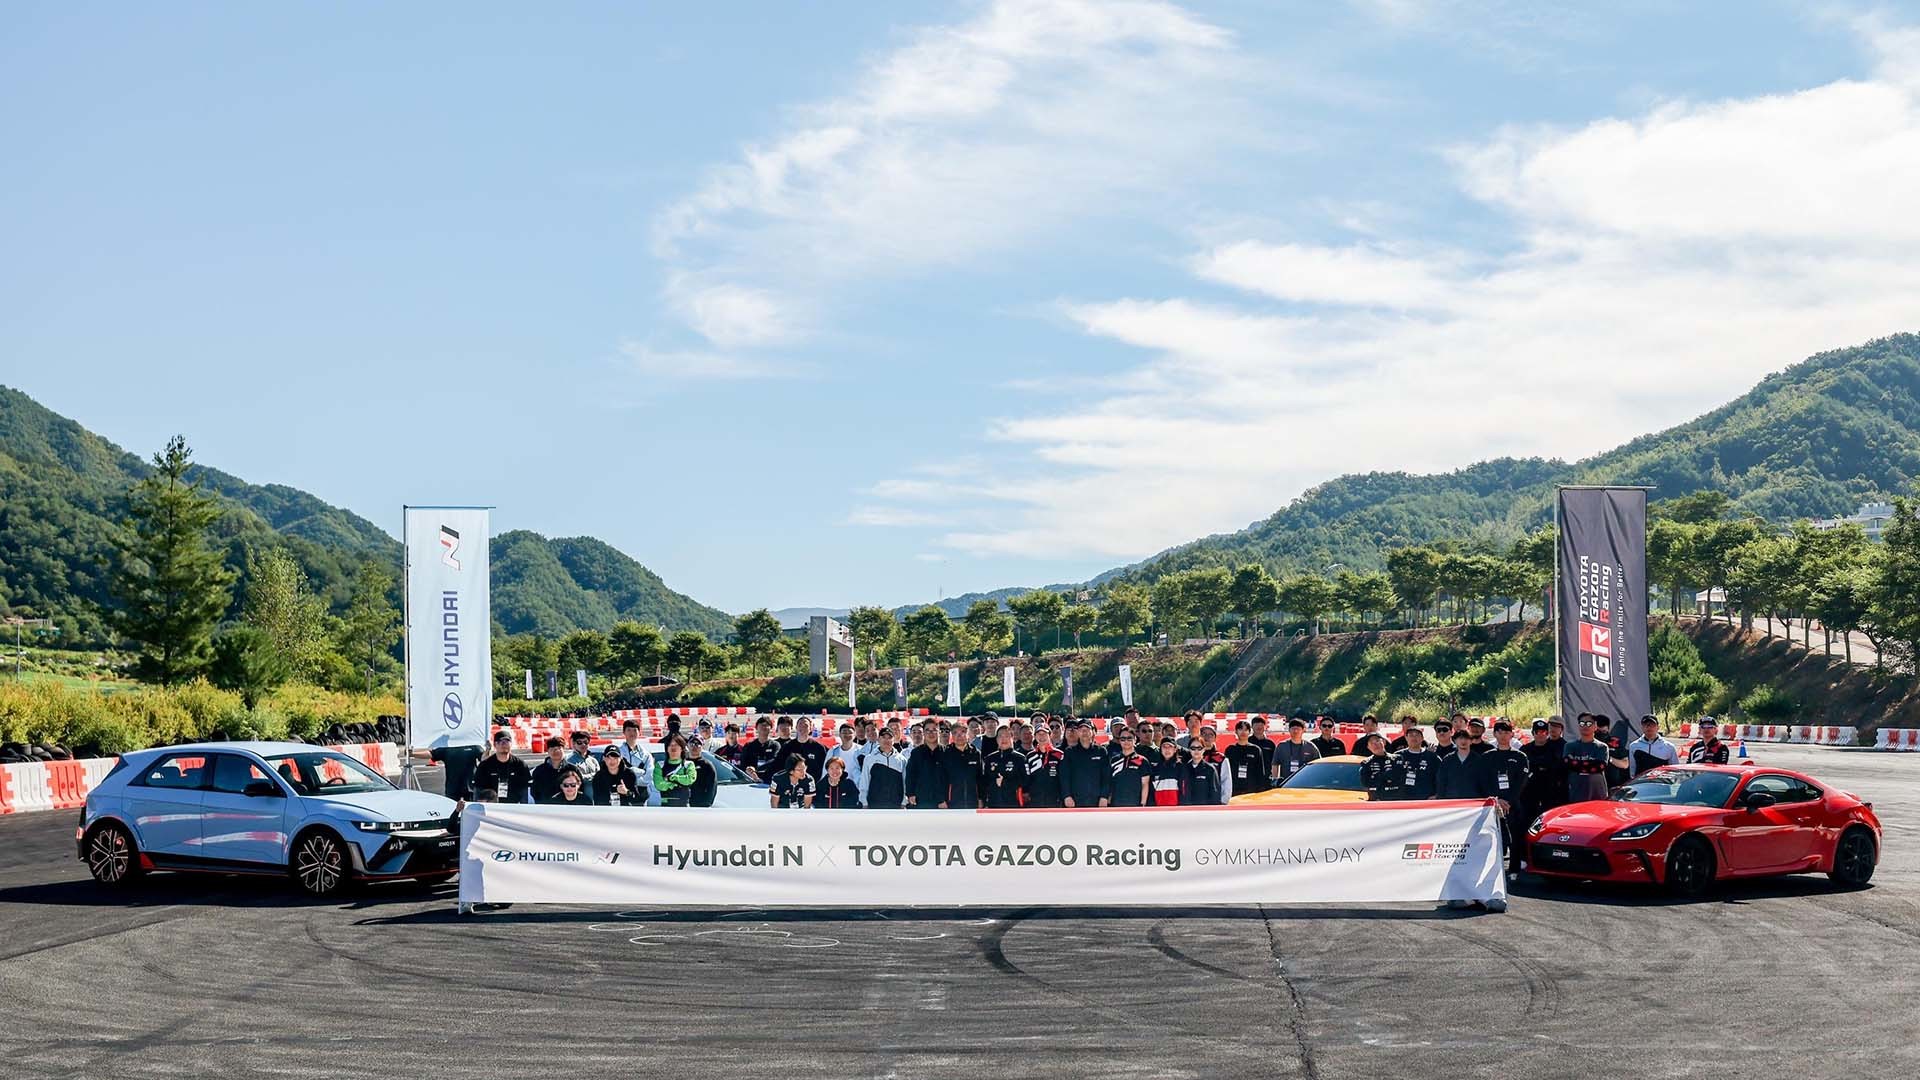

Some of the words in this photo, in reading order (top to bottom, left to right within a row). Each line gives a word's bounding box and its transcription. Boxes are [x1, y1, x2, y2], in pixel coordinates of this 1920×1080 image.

[1580, 555, 1589, 618] TOYOTA
[1590, 562, 1599, 621] GAZOO
[1600, 565, 1612, 624] Racing
[443, 590, 459, 686] HYUNDAI
[1591, 627, 1610, 681] GR
[1618, 646, 1626, 676] Pushing
[518, 851, 580, 862] HYUNDAI
[653, 844, 774, 871] Hyundai
[783, 845, 804, 866] N
[849, 845, 966, 866] TOYOTA
[975, 844, 1078, 866] GAZOO
[1086, 843, 1182, 871] Racing
[1195, 848, 1317, 865] GYMKHANA
[1324, 847, 1365, 864] DAY
[1403, 849, 1432, 859] GR
